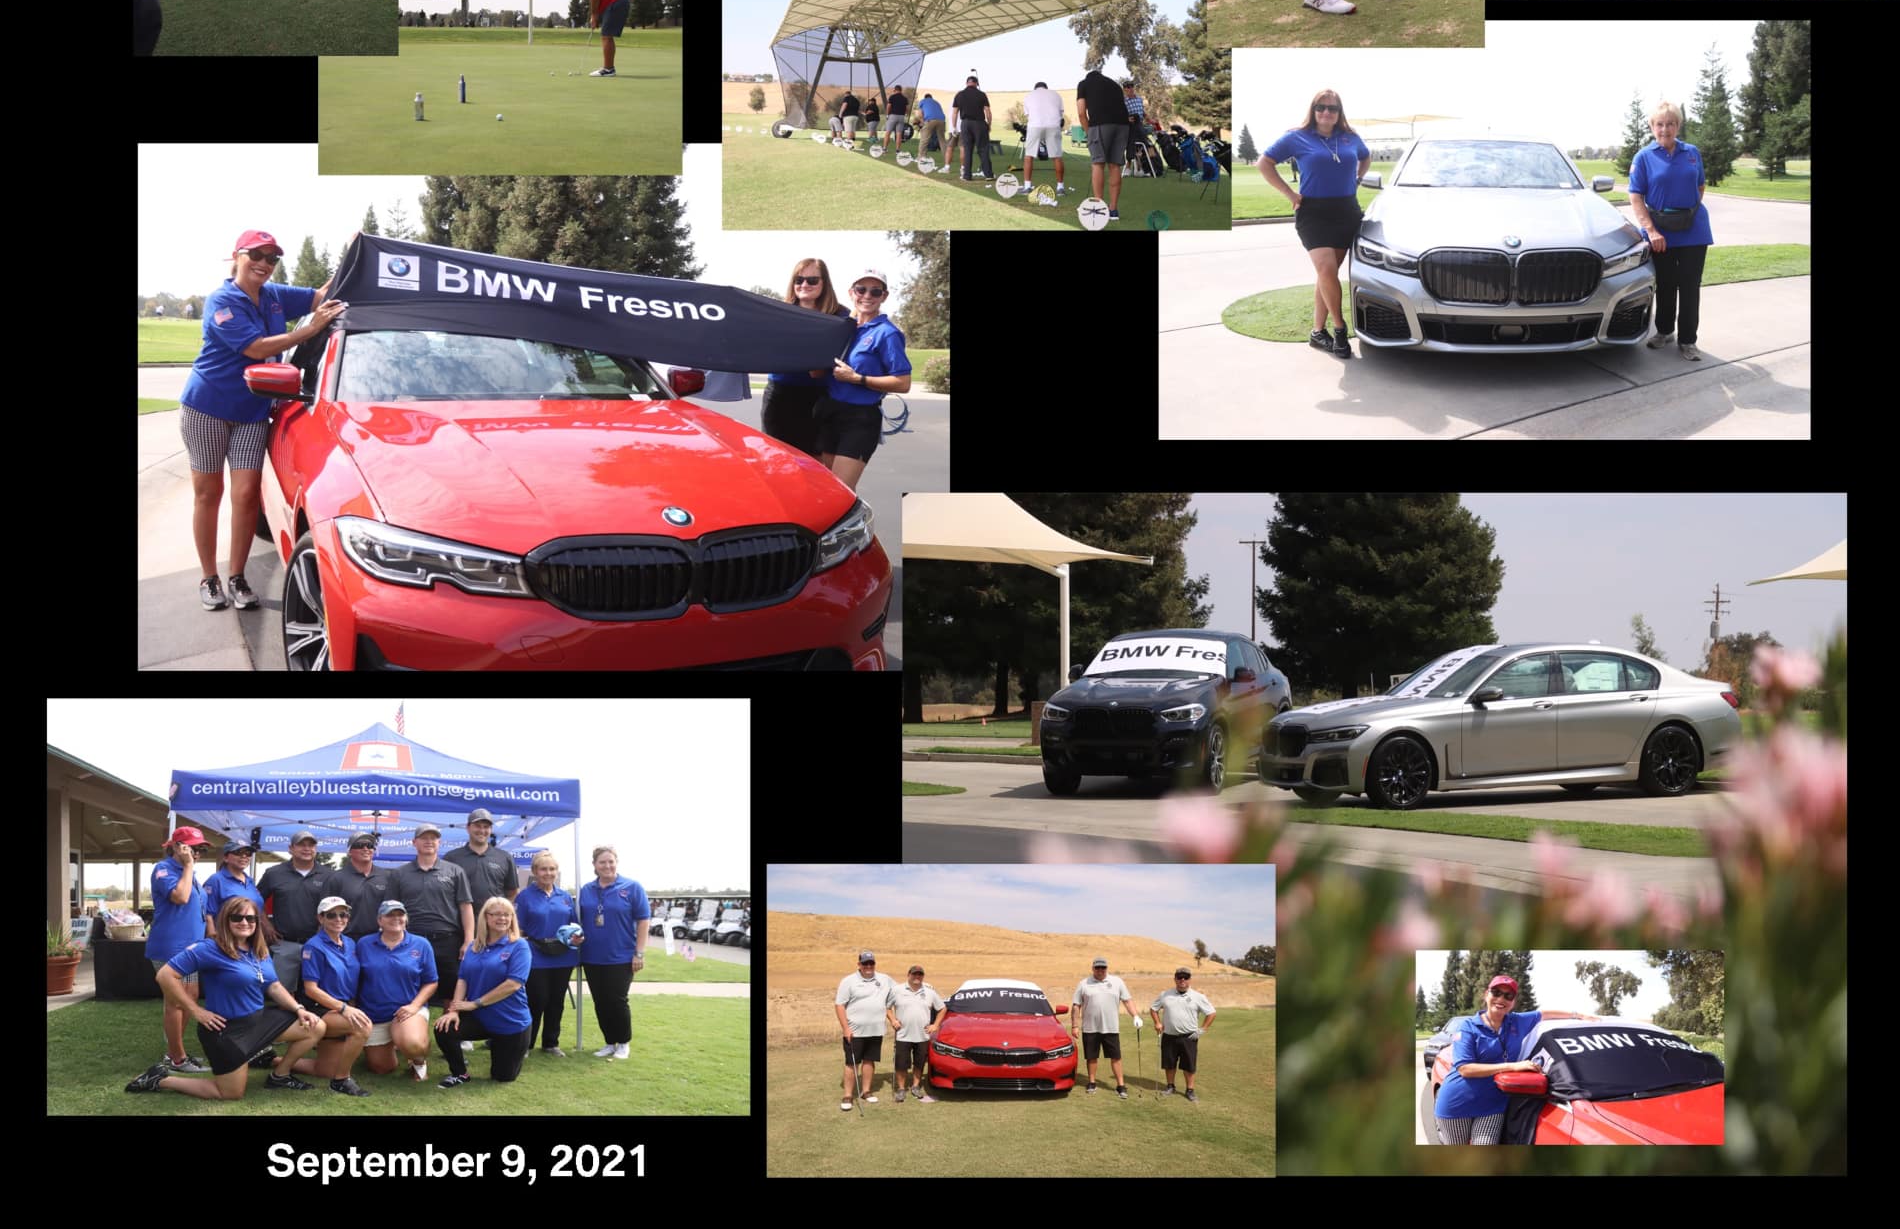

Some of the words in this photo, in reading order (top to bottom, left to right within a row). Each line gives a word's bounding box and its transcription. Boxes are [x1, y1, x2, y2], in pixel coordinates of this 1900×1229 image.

[437, 259, 557, 303] BMW
[579, 285, 726, 322] Fresno
[1100, 645, 1171, 662] BMW
[191, 777, 560, 802] centralvalleybluestarmoms@gmail.com
[954, 990, 993, 1000] BMW
[1553, 1033, 1636, 1055] BMW
